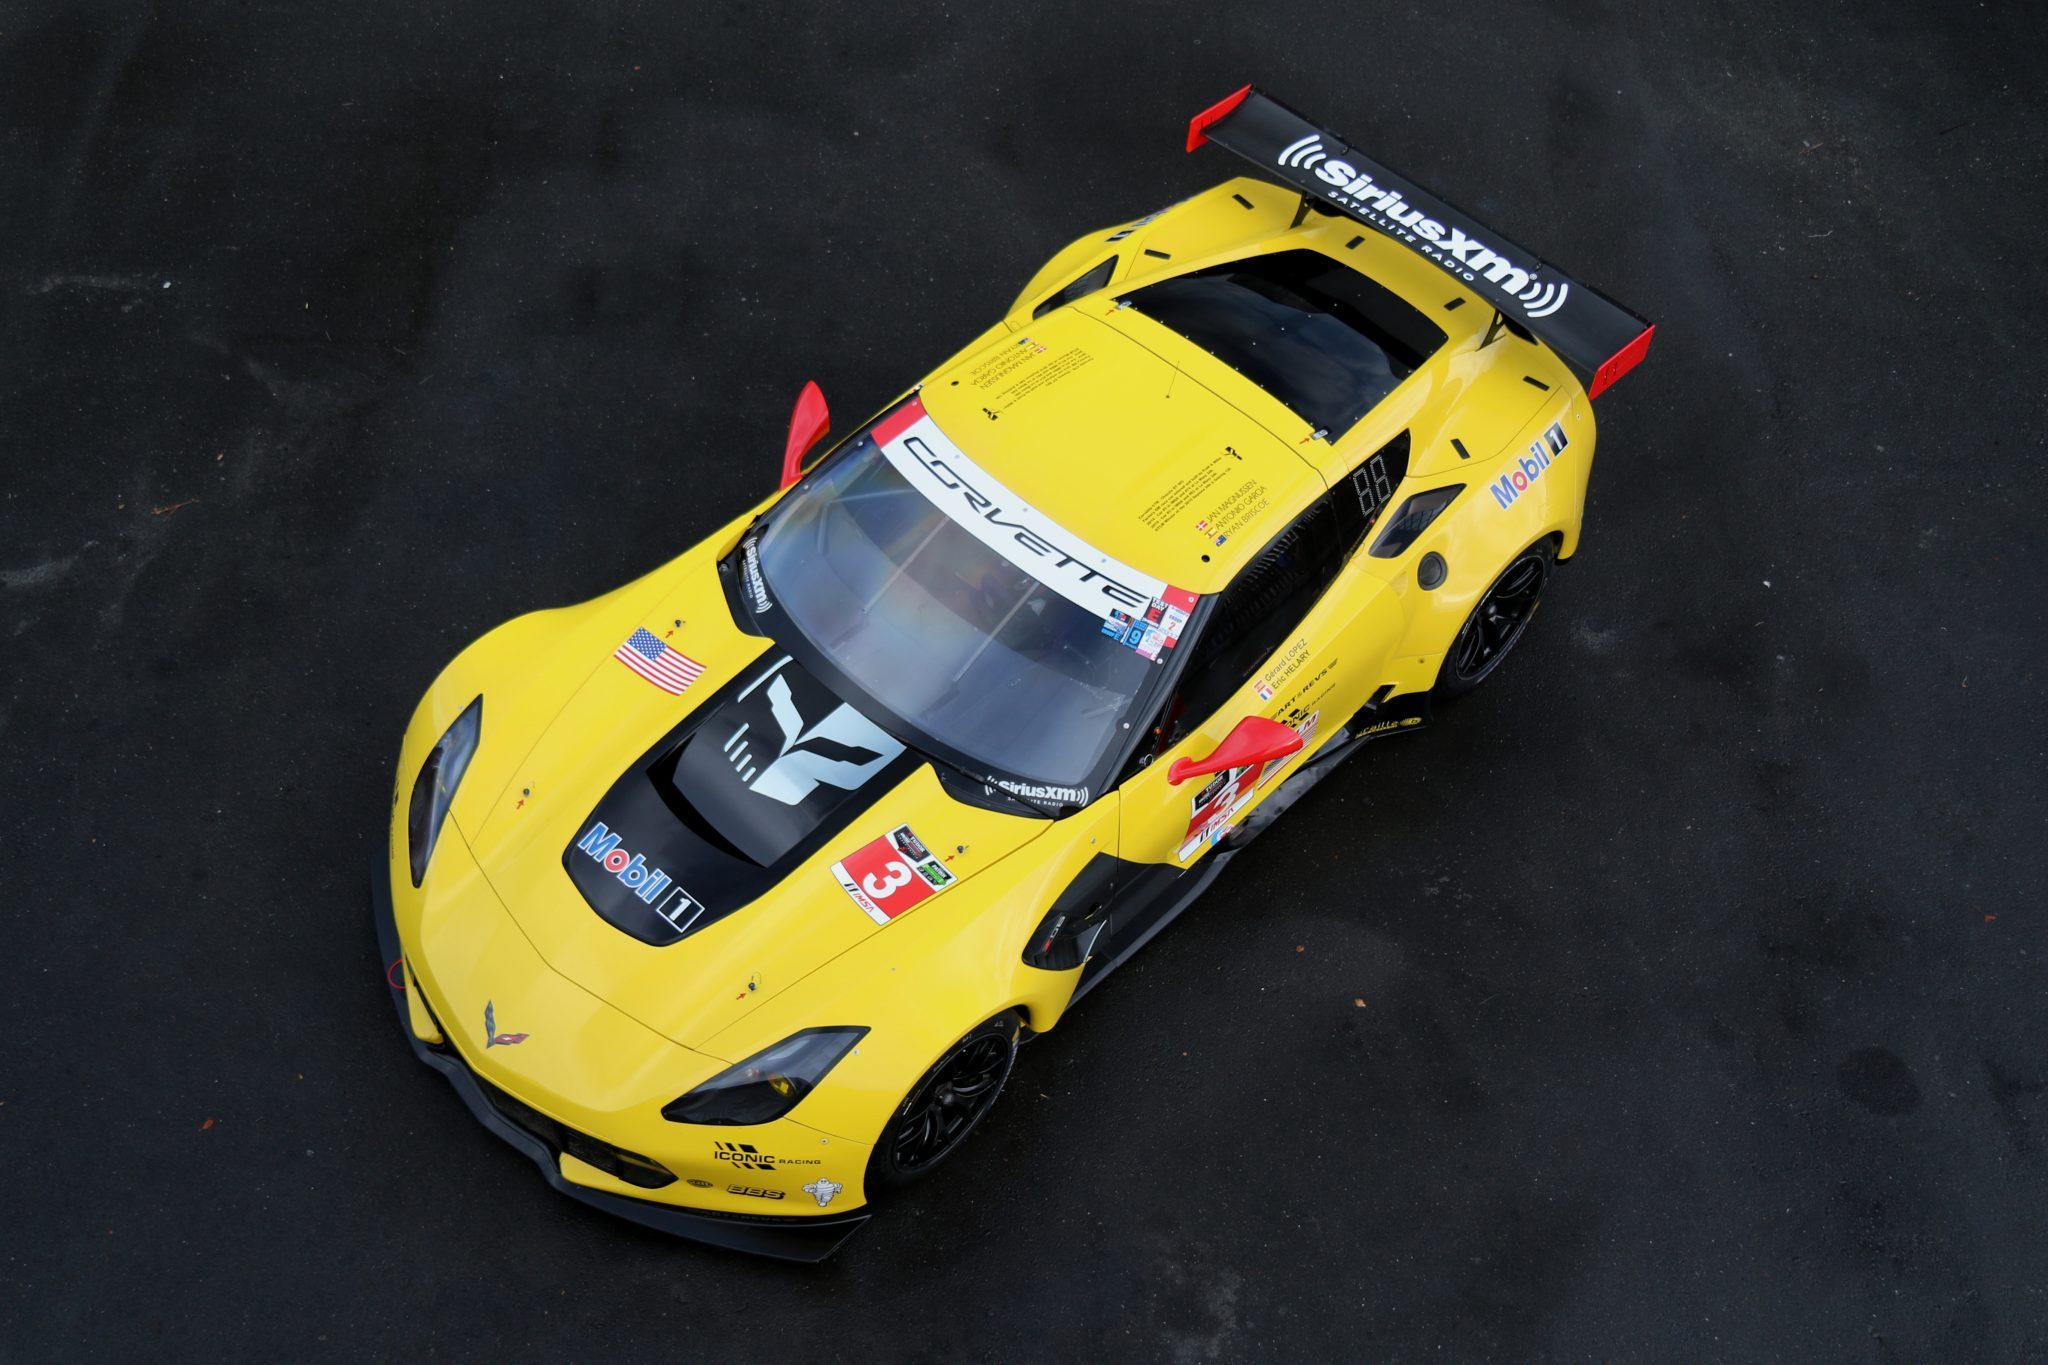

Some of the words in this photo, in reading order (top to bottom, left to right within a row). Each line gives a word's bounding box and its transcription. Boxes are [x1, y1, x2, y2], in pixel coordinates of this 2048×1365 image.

[1327, 189, 1414, 243] SATELLITE
[1420, 245, 1475, 281] RADIO
[1490, 441, 1549, 510] Mobil
[1206, 508, 1220, 522] JAN
[1217, 478, 1256, 512] MAGNUSSEN
[1214, 501, 1245, 529] ANTONIO
[1242, 484, 1266, 506] GARCIA
[1223, 520, 1243, 538] RYAN
[1240, 497, 1269, 523] BRISCOE
[903, 436, 1150, 609] CORVETTE
[1128, 628, 1143, 645] 9
[1263, 658, 1286, 682] Gerard
[1284, 638, 1307, 661] LOPEZ
[1270, 673, 1286, 689] Eric
[1283, 649, 1309, 676] HELARY
[1278, 695, 1295, 715] ART
[1302, 668, 1327, 693] REVS
[578, 822, 672, 904] Mobil
[862, 861, 912, 899] 3
[853, 892, 874, 912] IMSA
[714, 1151, 775, 1164] ICONIC
[728, 1184, 786, 1200] BBS
